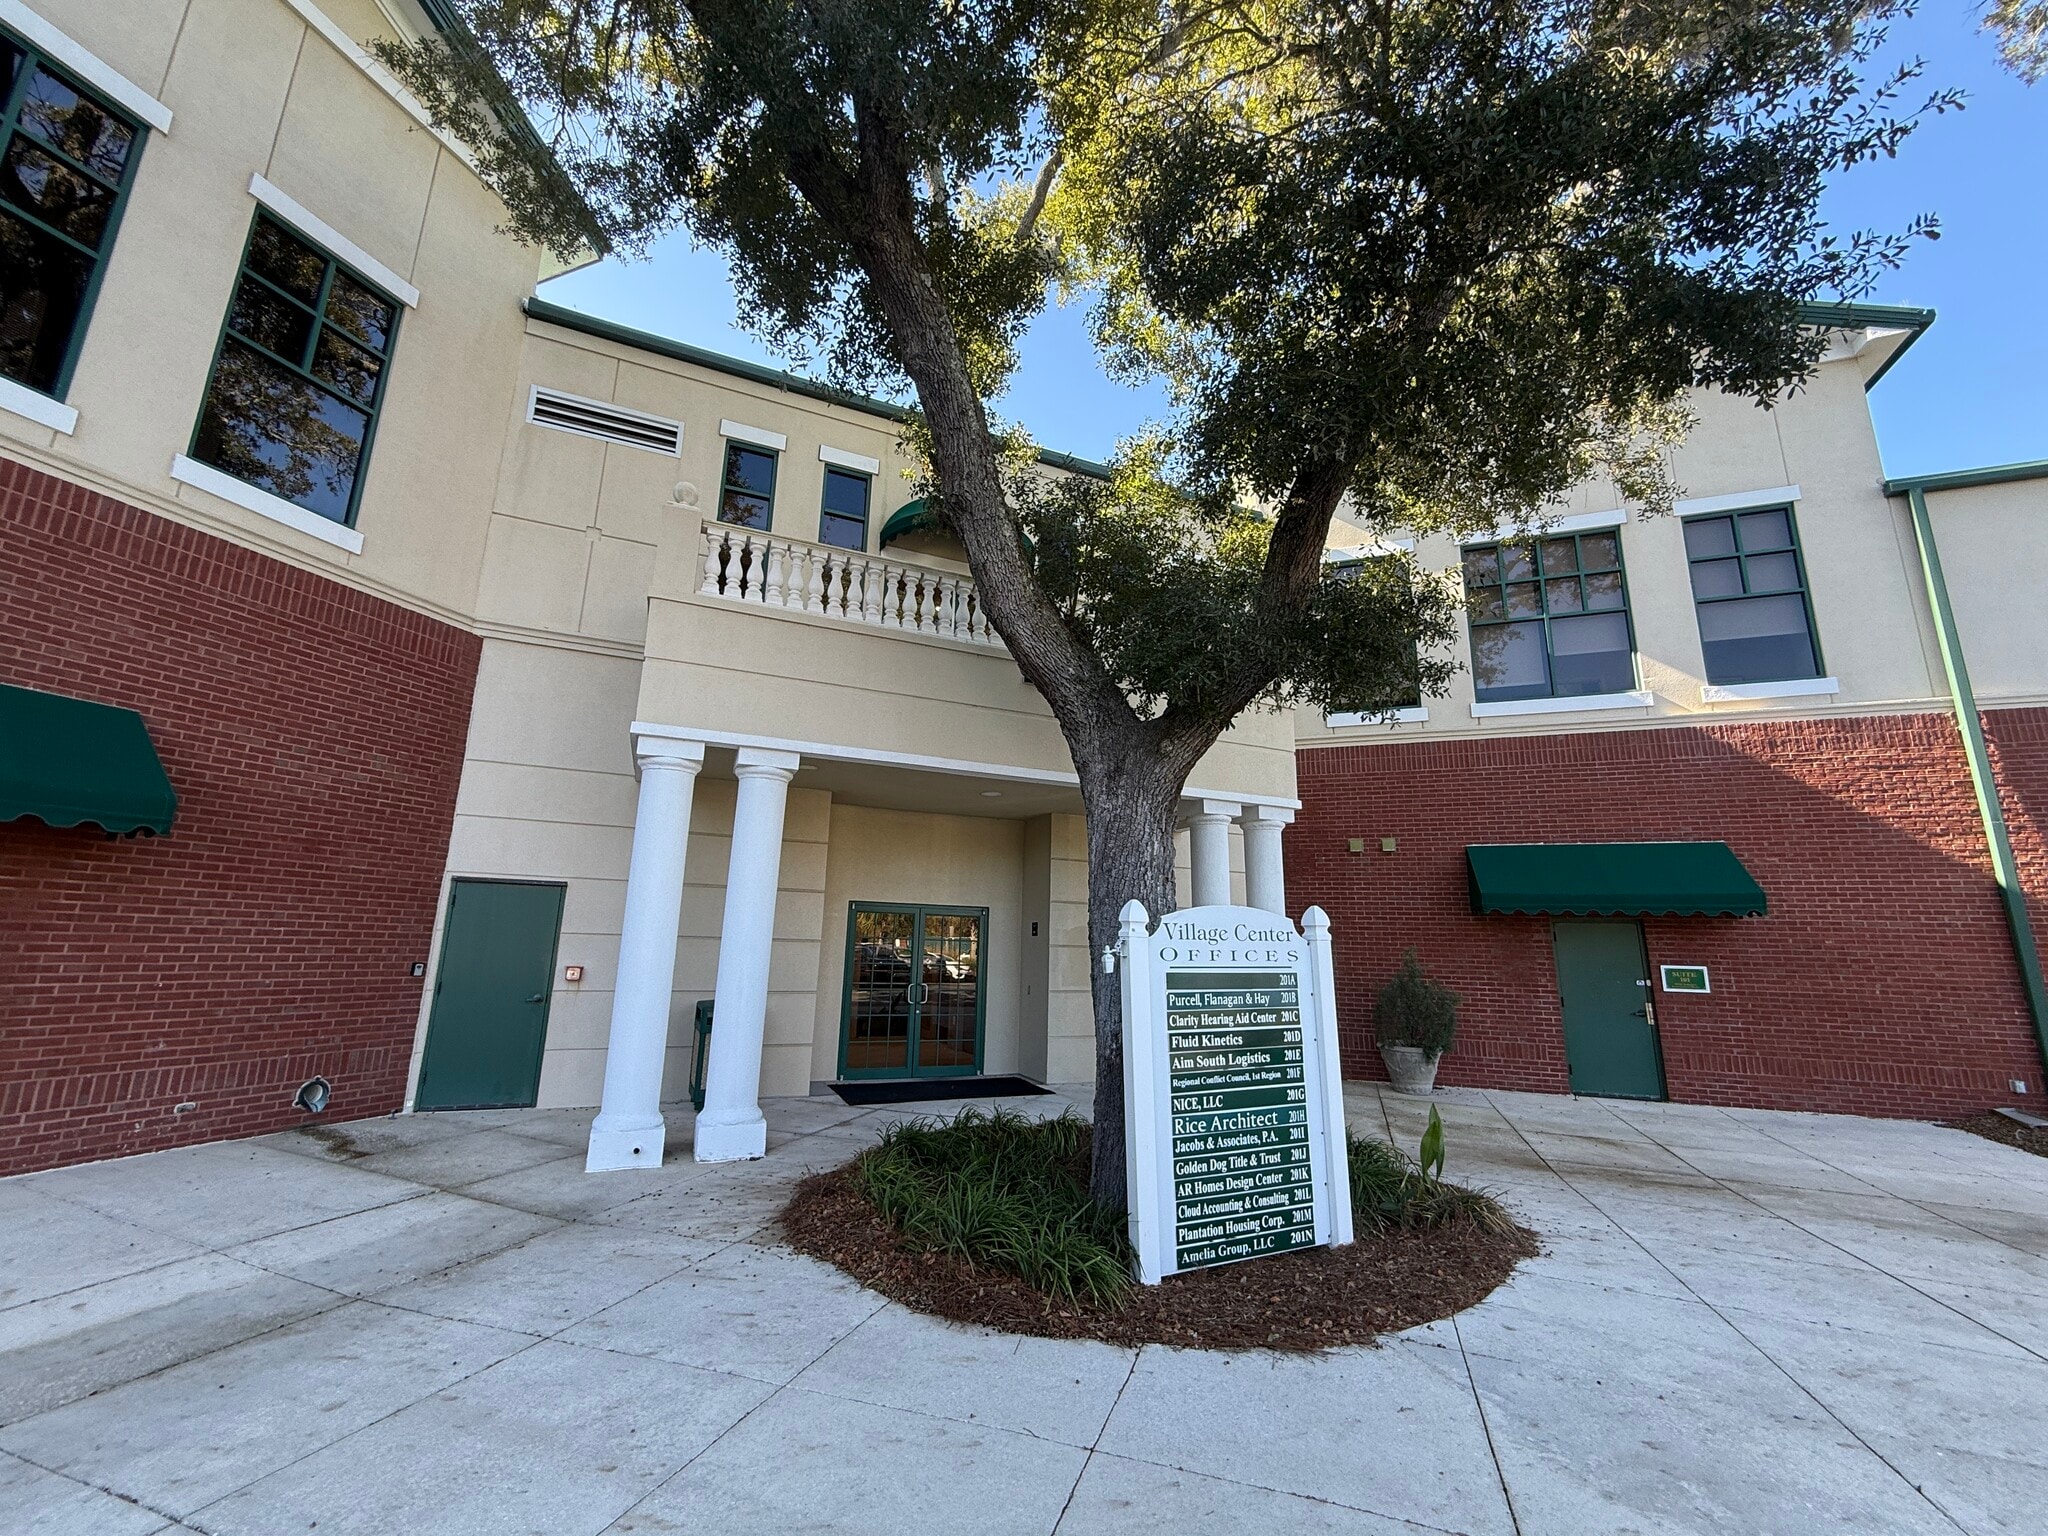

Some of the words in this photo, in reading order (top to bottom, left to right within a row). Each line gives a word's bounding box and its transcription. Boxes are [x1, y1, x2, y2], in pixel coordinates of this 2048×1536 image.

[1164, 923, 1228, 945] Village
[1235, 924, 1293, 942] Center
[1160, 947, 1298, 962] OFFICES
[1280, 975, 1295, 985] 201A
[1169, 994, 1202, 1007] Purcell,
[1205, 994, 1244, 1007] Flanagan
[1245, 994, 1252, 1003] &
[1254, 993, 1270, 1006] Hay
[1281, 992, 1296, 1003] 201B
[1169, 1014, 1199, 1028] Clarity
[1201, 1014, 1233, 1027] Hearing
[1235, 1013, 1249, 1023] Aid
[1251, 1012, 1276, 1023] Center
[1281, 1011, 1298, 1022] 201C
[1172, 1035, 1199, 1048] Fluid
[1202, 1034, 1243, 1046] Kinetics
[1283, 1031, 1300, 1042] 201D
[1172, 1057, 1195, 1069] Aim
[1197, 1055, 1226, 1067] South
[1228, 1052, 1270, 1067] Logistics
[1285, 1049, 1301, 1061] 201E
[1173, 1078, 1200, 1088] Regional
[1201, 1075, 1225, 1084] Conflict
[1227, 1073, 1251, 1082] Council,
[1252, 1072, 1260, 1080] 1st
[1261, 1070, 1281, 1080] Region
[1287, 1068, 1301, 1078] 201F
[1173, 1098, 1201, 1111] NICE,
[1203, 1095, 1223, 1108] LLC
[1287, 1089, 1304, 1100] 201G
[1175, 1118, 1206, 1134] Rice
[1211, 1112, 1278, 1131] Architect
[1289, 1110, 1305, 1122] 201H
[1175, 1138, 1204, 1154] Jacobs
[1207, 1137, 1214, 1149] &
[1217, 1133, 1260, 1148] Associates,
[1262, 1130, 1278, 1142] P.A.
[1176, 1161, 1207, 1175] Golden
[1210, 1159, 1227, 1173] Dog
[1228, 1155, 1247, 1169] Title
[1250, 1154, 1257, 1165] &
[1259, 1152, 1281, 1164] Trust
[1291, 1148, 1306, 1160] 201J
[1178, 1183, 1192, 1197] AR
[1195, 1180, 1224, 1195] Homes
[1226, 1176, 1254, 1190] Design
[1256, 1173, 1283, 1186] Center
[1290, 1167, 1308, 1180] 201K
[1178, 1204, 1201, 1218] Cloud
[1203, 1199, 1243, 1215] Accounting
[1244, 1196, 1251, 1209] &
[1253, 1192, 1289, 1207] Consulting
[1294, 1188, 1311, 1200] 201L
[1178, 1224, 1223, 1242] Plantation
[1226, 1218, 1260, 1232] Housing
[1262, 1215, 1285, 1228] Corp.
[1292, 1208, 1312, 1223] 201M
[1182, 1247, 1215, 1264] Amelia
[1218, 1242, 1251, 1256] Group,
[1254, 1236, 1274, 1250] LLC
[1291, 1230, 1312, 1244] 201N
